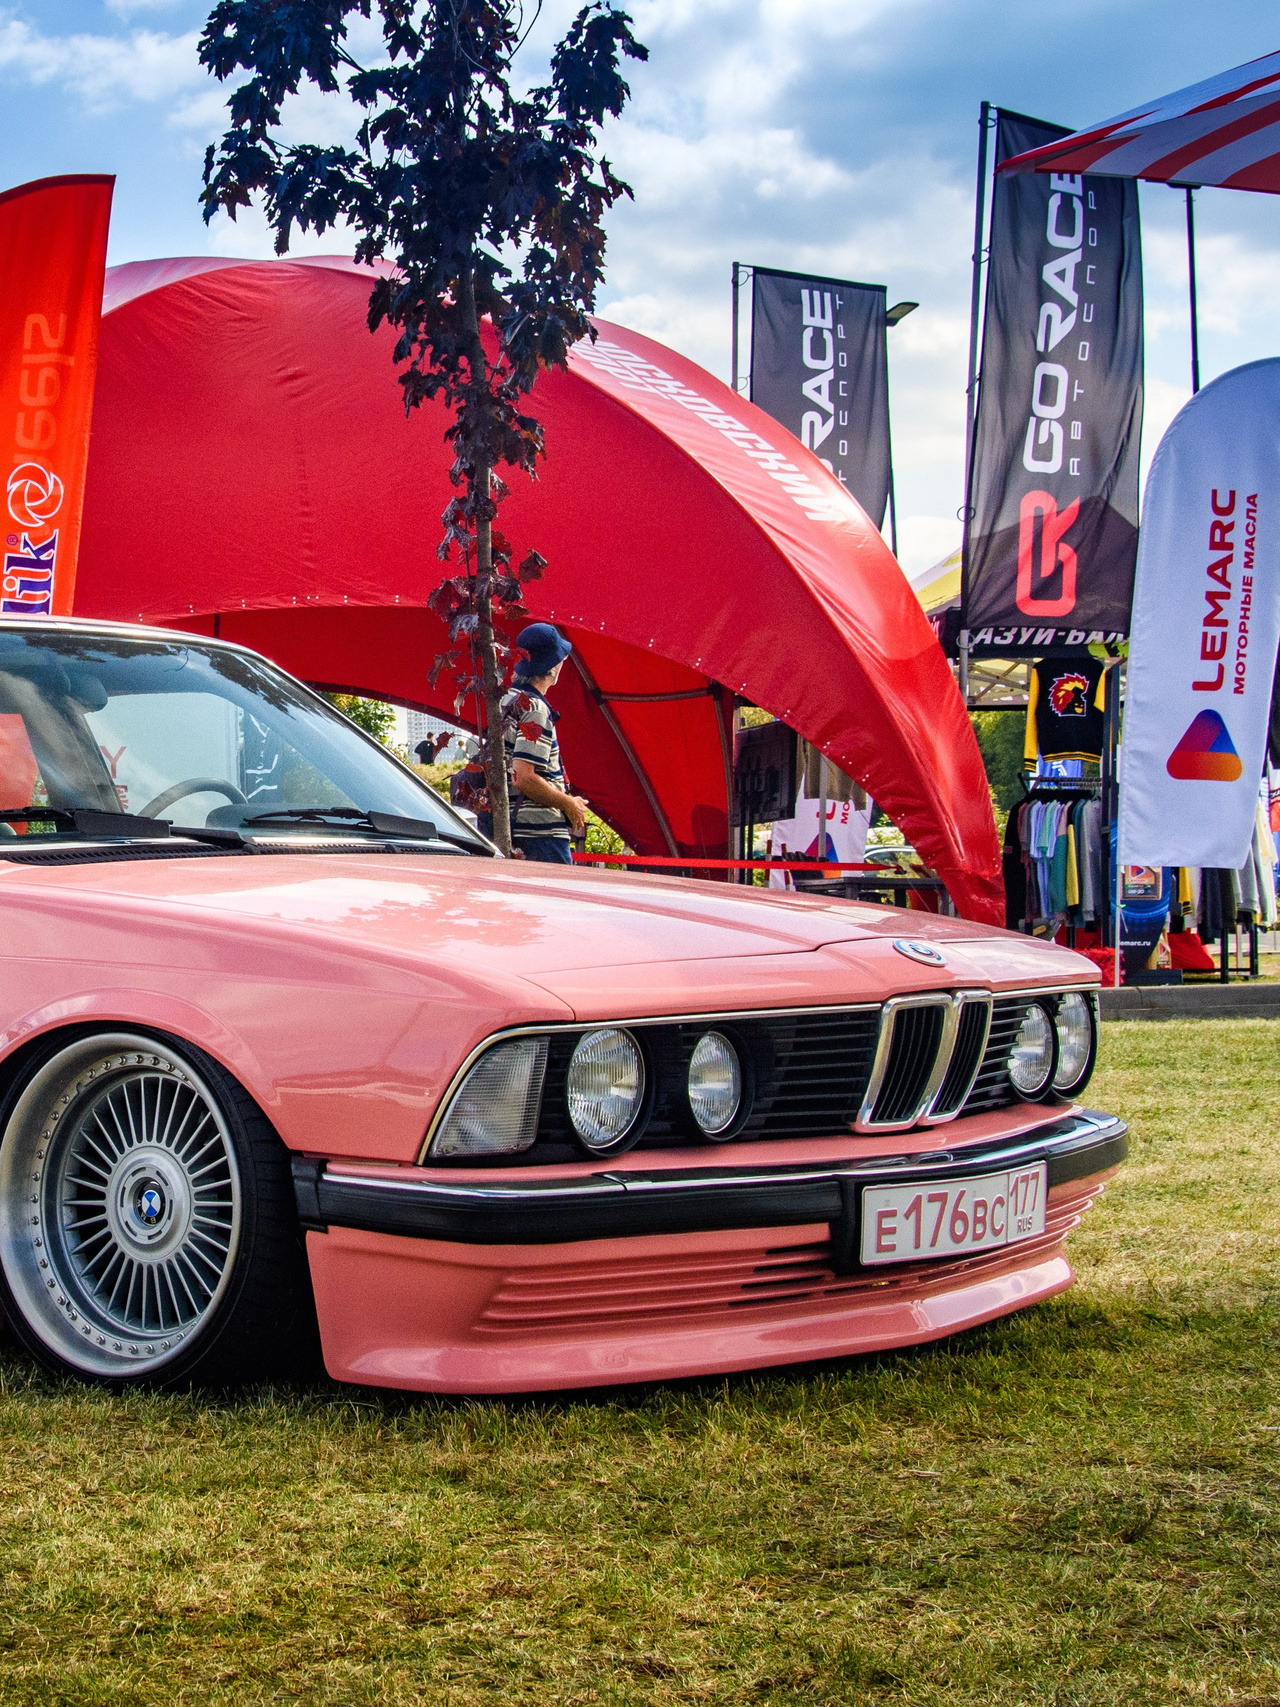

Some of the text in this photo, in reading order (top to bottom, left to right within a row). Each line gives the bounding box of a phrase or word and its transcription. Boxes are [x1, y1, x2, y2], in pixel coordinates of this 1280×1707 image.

[1069, 190, 1098, 476] АВТОСПОР
[1023, 362, 1069, 473] GO
[1192, 488, 1237, 691] LEMARC
[1233, 492, 1259, 695] МОТОРНЫЕ МАСЛА
[1010, 1169, 1040, 1216] 177
[1016, 1217, 1033, 1234] RUS
